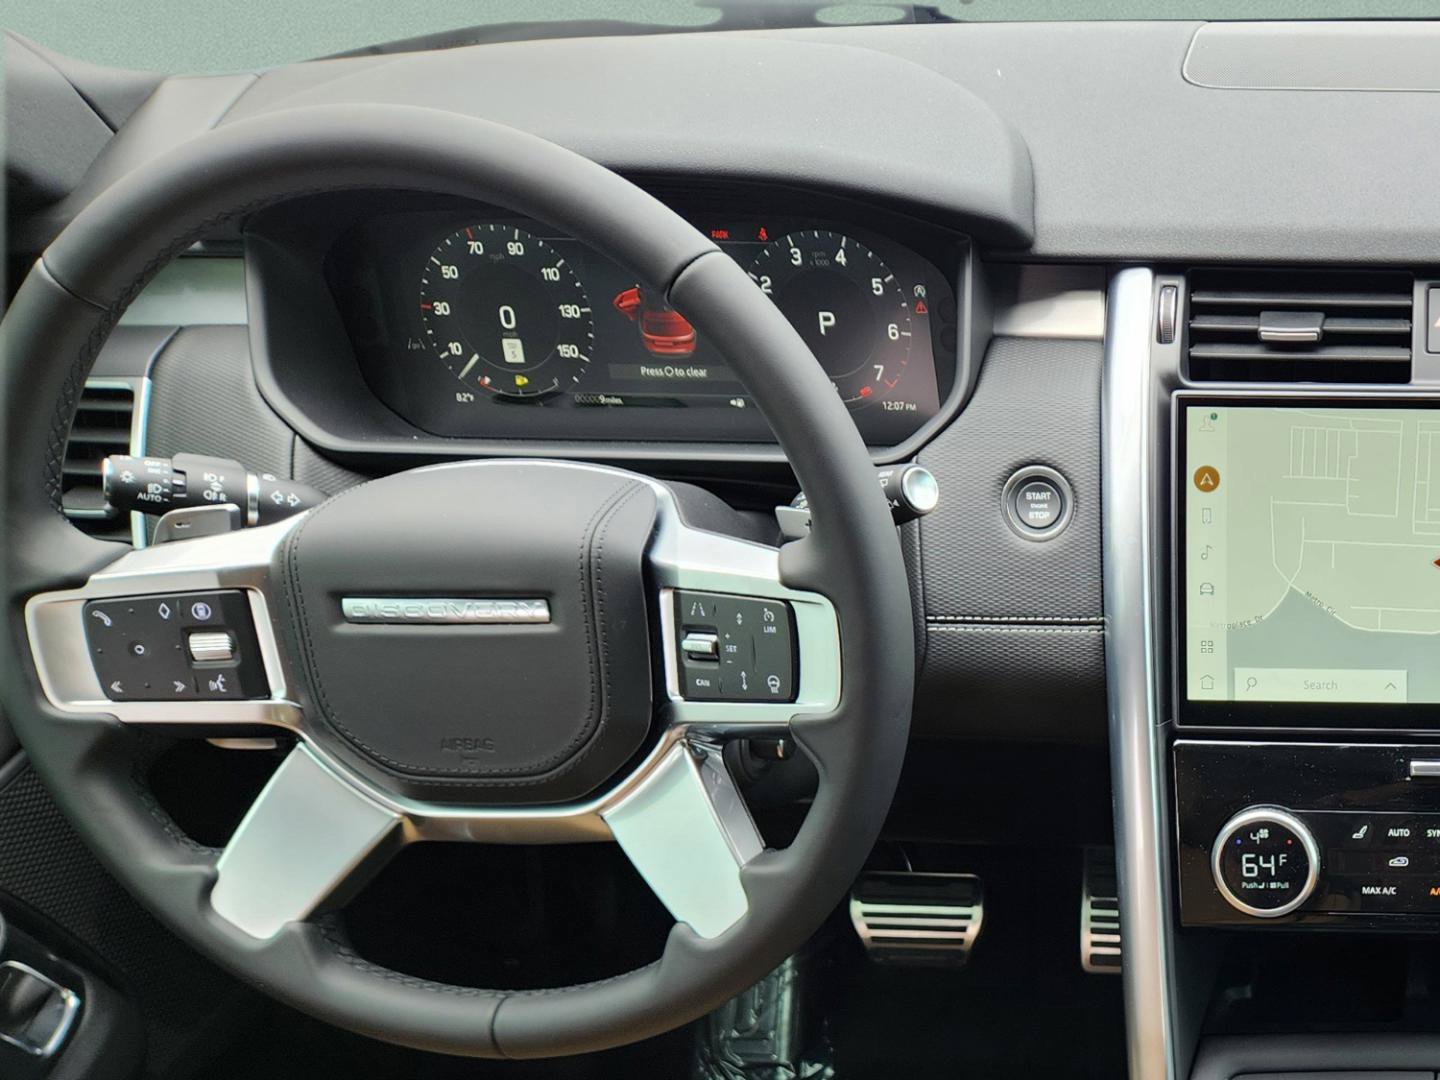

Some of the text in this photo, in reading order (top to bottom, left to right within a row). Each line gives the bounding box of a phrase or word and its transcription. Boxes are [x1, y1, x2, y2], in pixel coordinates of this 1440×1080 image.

[467, 241, 484, 255] 70
[507, 241, 524, 256] 90
[789, 247, 802, 266] 3
[835, 248, 847, 267] 4
[441, 265, 459, 280] 50
[541, 266, 561, 282] 110
[760, 275, 773, 294] 2
[871, 278, 884, 296] 5
[433, 302, 450, 316] 30
[558, 304, 581, 319] 130
[498, 305, 517, 330] 0
[818, 311, 836, 336] P
[887, 323, 899, 341] 6
[448, 342, 463, 356] 10
[557, 343, 579, 359] 150
[640, 366, 707, 378] Press to clear
[873, 364, 884, 381] 7
[882, 401, 917, 411] 12:07 PM
[136, 491, 163, 503] AUTO
[1026, 492, 1051, 501] START
[1028, 511, 1051, 520] STOP
[763, 625, 777, 634] LIM
[725, 644, 738, 653] SET
[695, 677, 711, 687] CAN
[1303, 680, 1339, 690] Search
[440, 737, 495, 751] AIRBAG
[1388, 828, 1410, 837] AUTO
[1242, 853, 1288, 877] 64 F
[1241, 881, 1258, 889] Push
[1362, 886, 1397, 895] MAX A/C
